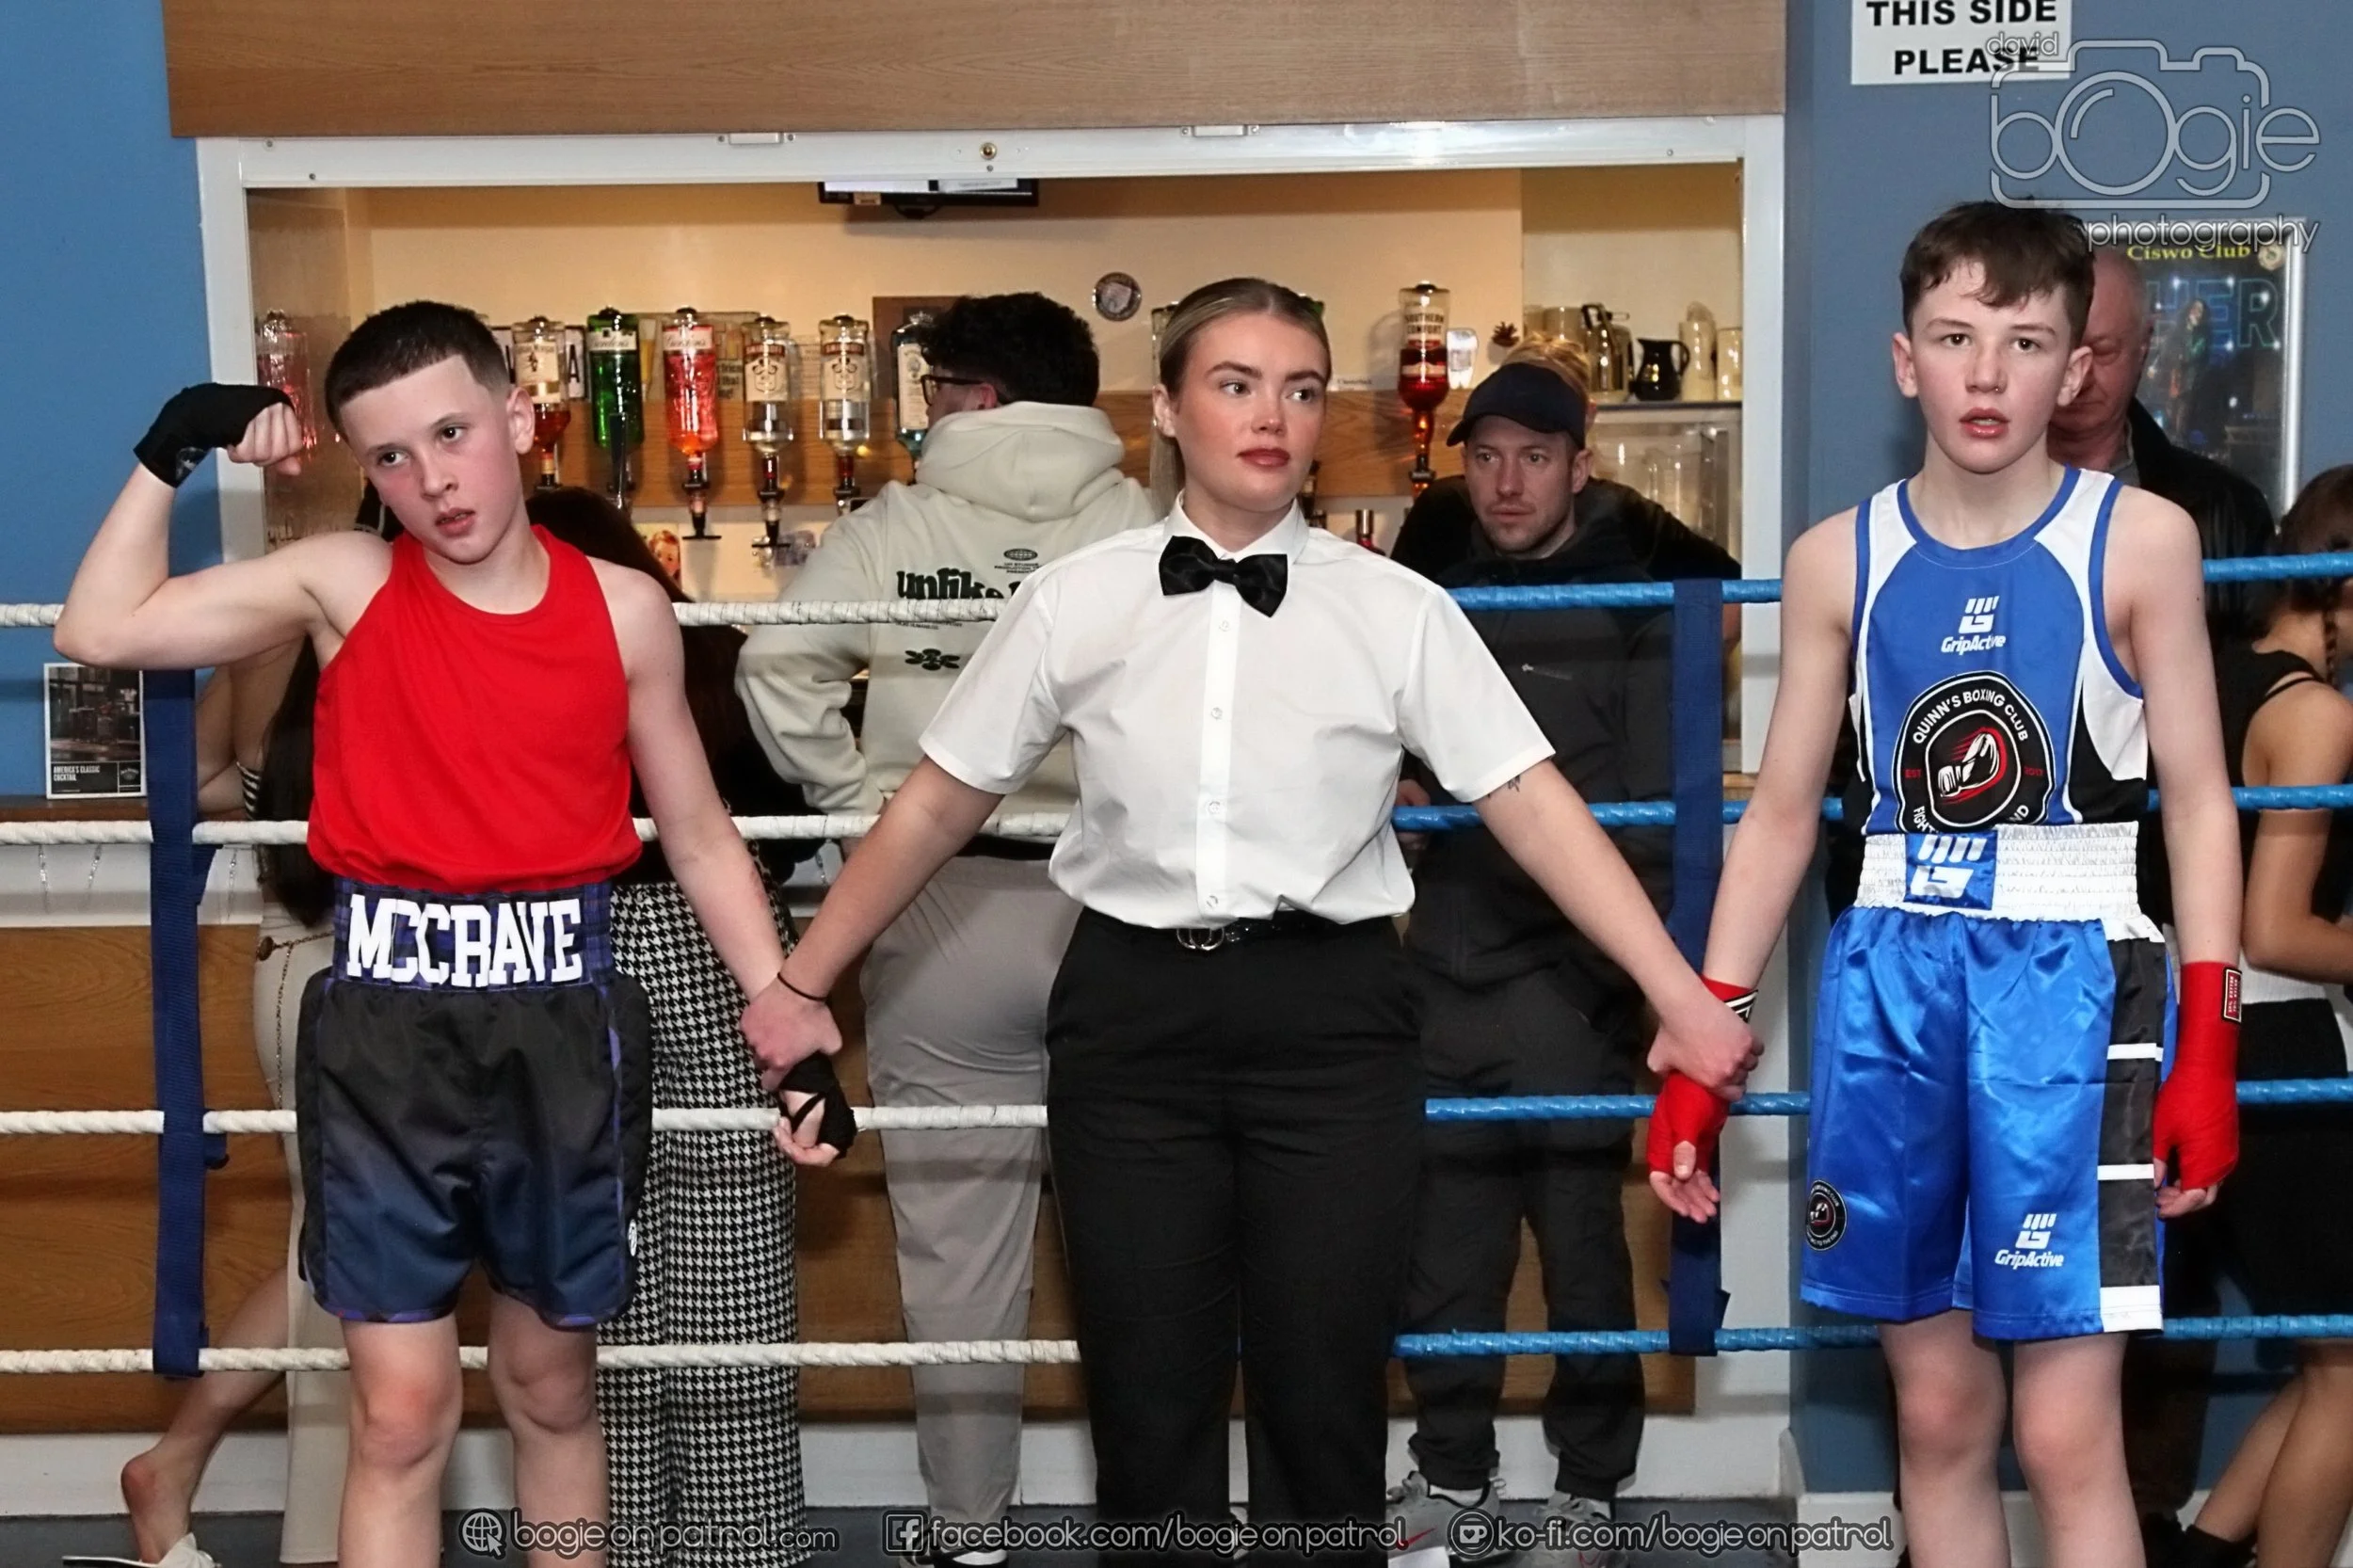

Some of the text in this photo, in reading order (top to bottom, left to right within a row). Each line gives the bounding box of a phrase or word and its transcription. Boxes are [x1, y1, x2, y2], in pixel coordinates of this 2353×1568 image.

[1866, 0, 2057, 26] THIS SIDE
[1894, 47, 2041, 75] PLEASE
[2127, 242, 2250, 261] Ciswo Club
[1913, 688, 2029, 744] QUINN'S BOXING CLUB
[1904, 768, 1923, 778] EST
[1994, 1249, 2064, 1271] GripActive
